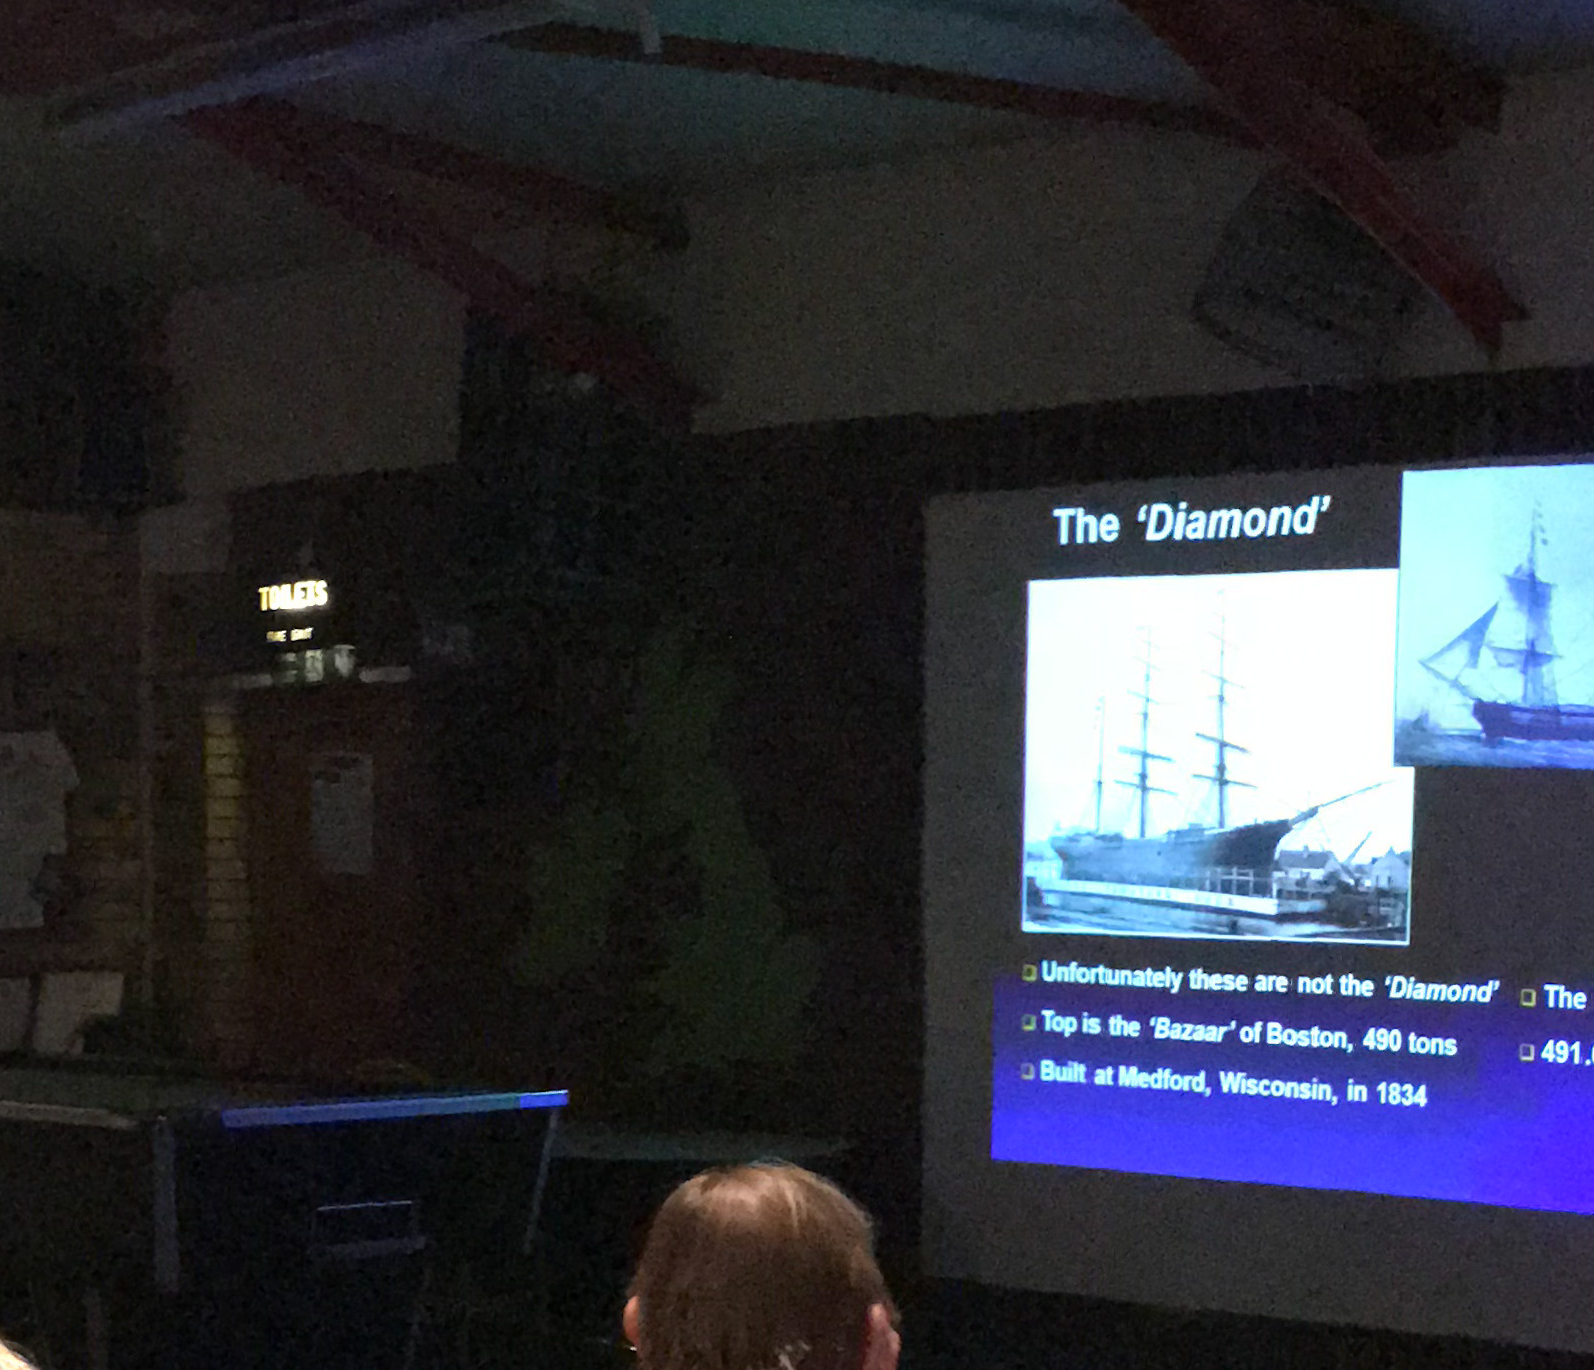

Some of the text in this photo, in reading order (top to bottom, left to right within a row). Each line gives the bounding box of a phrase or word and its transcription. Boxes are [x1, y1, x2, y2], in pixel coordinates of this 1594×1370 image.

[1052, 495, 1331, 545] The ‘Diamond’
[258, 579, 328, 611] TOILETS
[1041, 959, 1183, 994] Unfortunately
[1189, 967, 1248, 993] these
[1254, 974, 1288, 993] are
[1297, 976, 1333, 996] not
[1339, 976, 1374, 998] the
[1543, 984, 1587, 1010] The
[1041, 1009, 1077, 1036] Top
[1082, 1013, 1101, 1035] is
[1108, 1013, 1141, 1038] the
[1239, 1023, 1263, 1045] of
[1266, 1024, 1354, 1053] Boston,
[1363, 1026, 1403, 1053] 490
[1408, 1032, 1459, 1056] tons
[1039, 1060, 1428, 1108] Built at Medford, Wisconsin, in 1834
